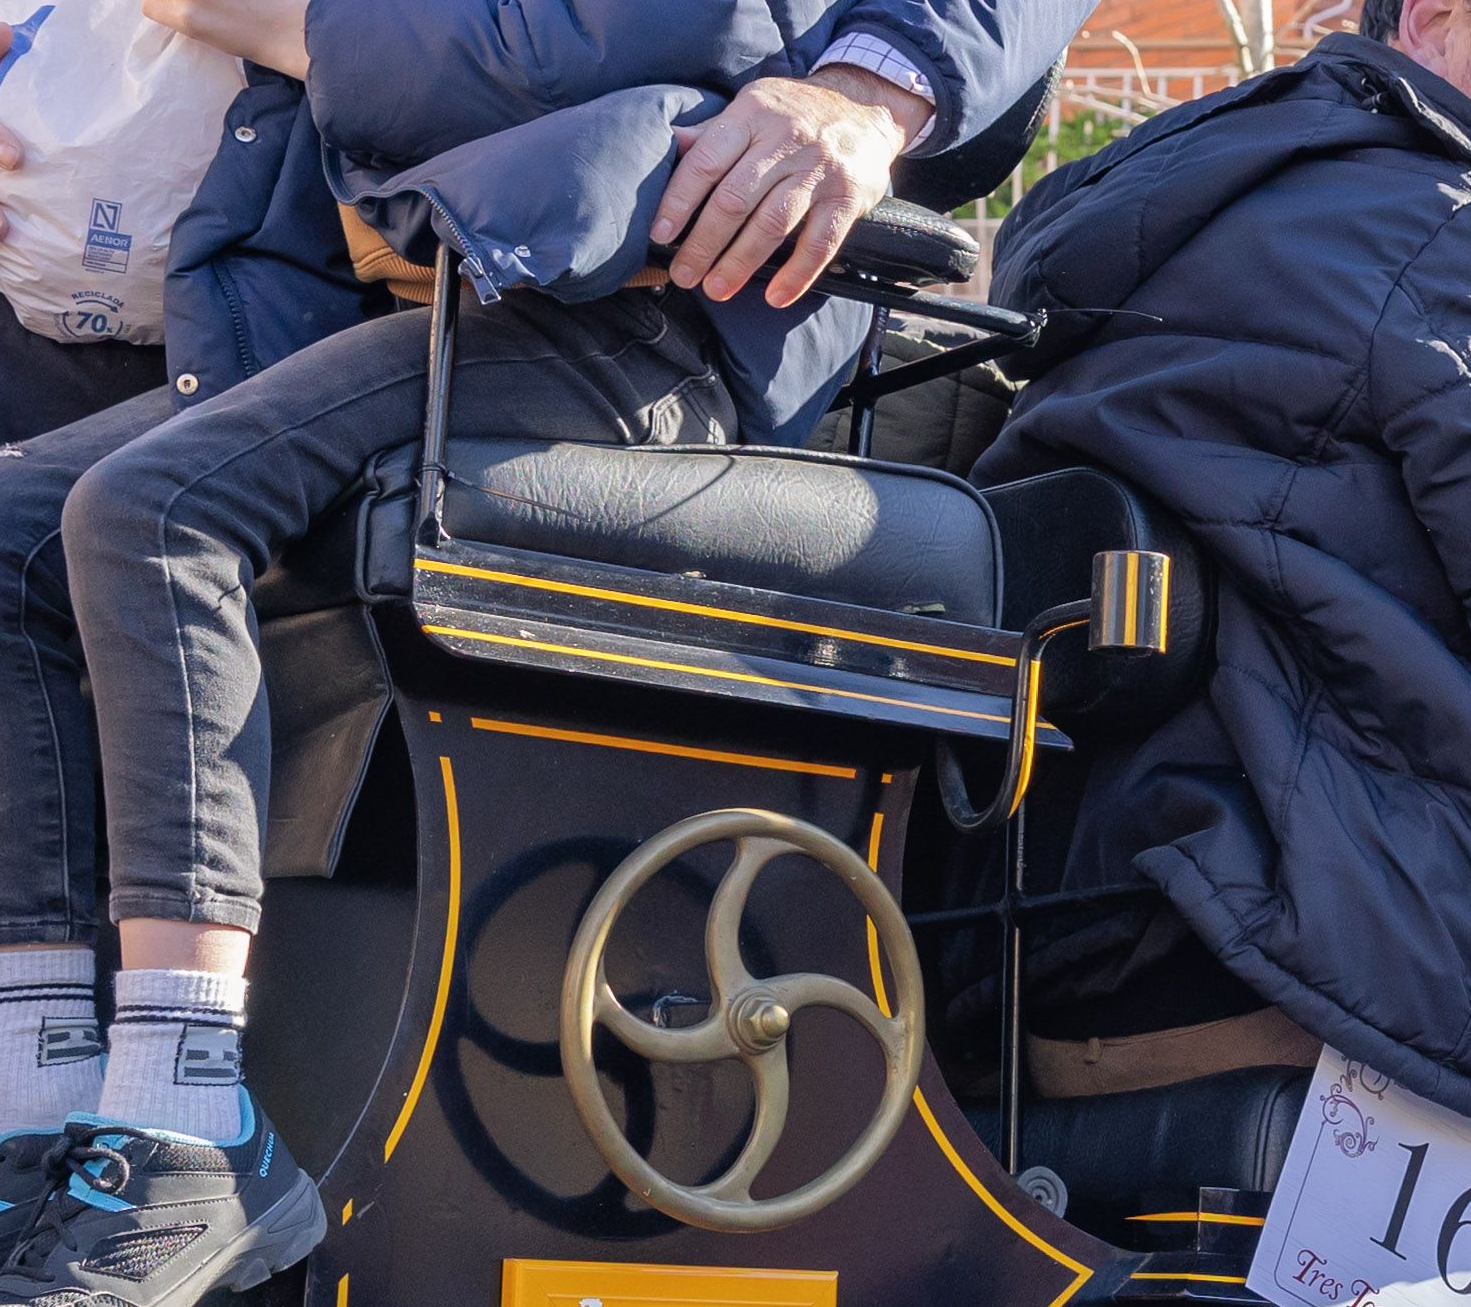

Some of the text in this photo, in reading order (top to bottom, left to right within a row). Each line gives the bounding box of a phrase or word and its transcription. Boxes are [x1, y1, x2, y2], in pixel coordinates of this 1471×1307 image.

[90, 234, 129, 248] AENOR
[71, 291, 125, 308] RECICLADA
[1293, 1248, 1343, 1300] Tres
